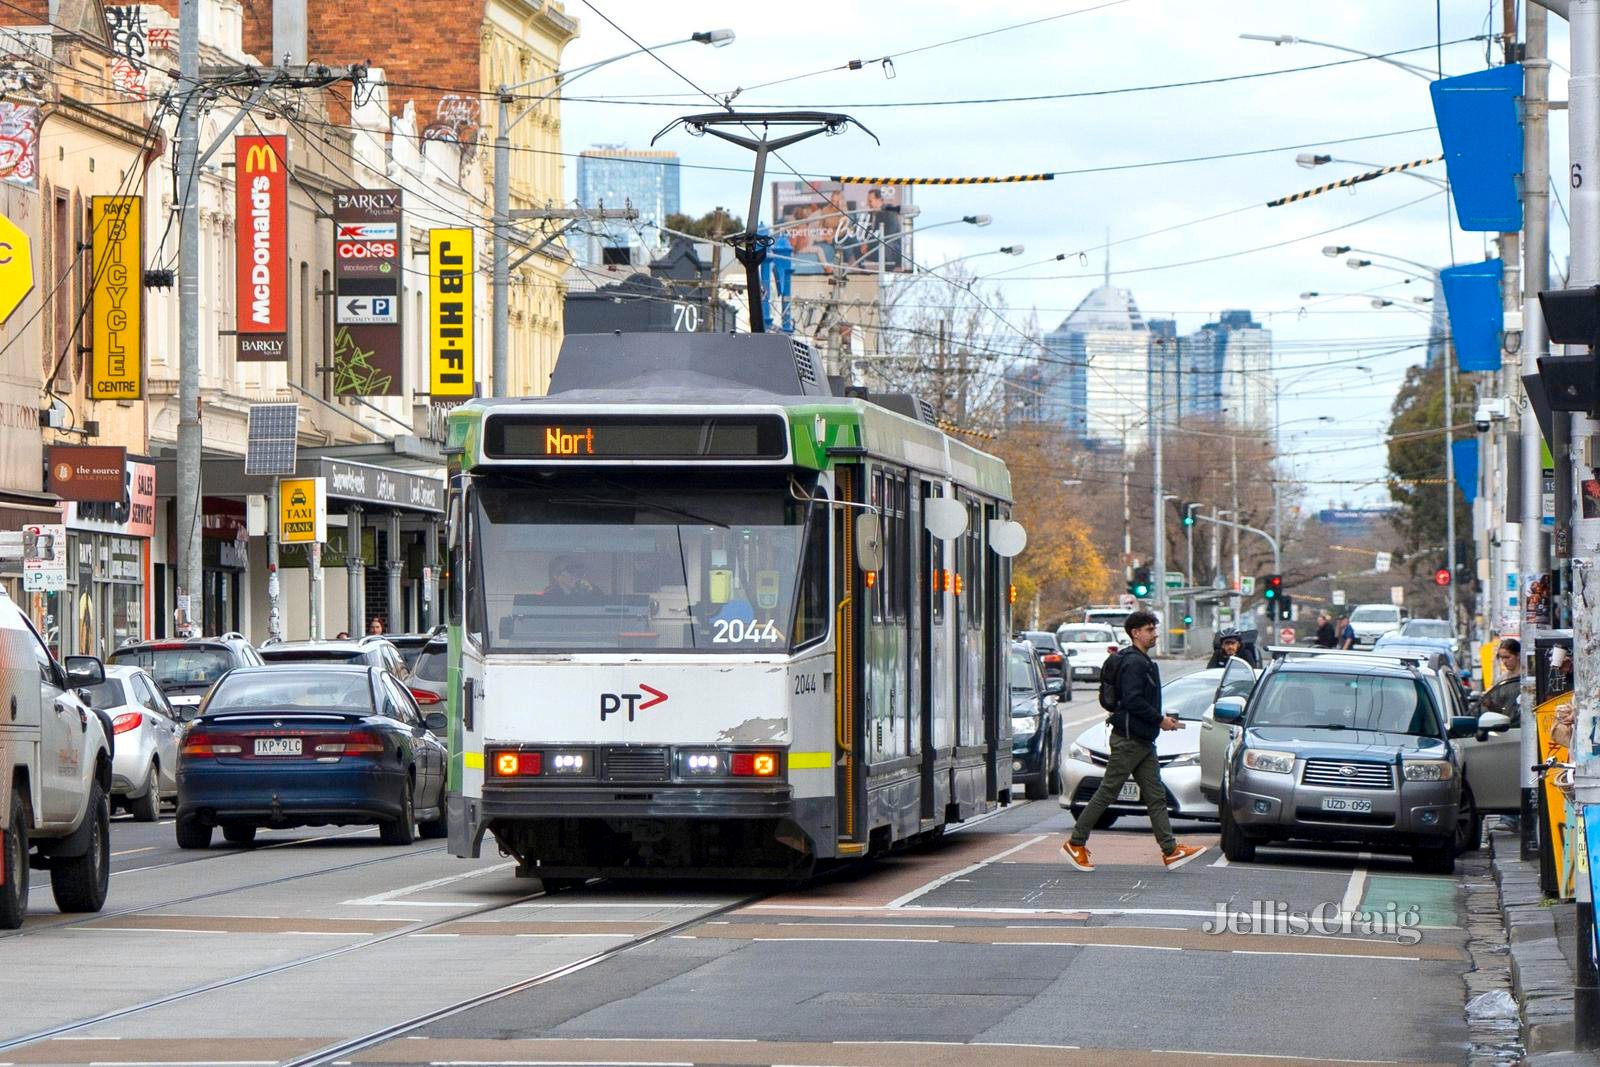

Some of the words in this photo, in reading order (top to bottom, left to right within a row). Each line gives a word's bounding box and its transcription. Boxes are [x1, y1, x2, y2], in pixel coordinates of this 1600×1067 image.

[1571, 163, 1583, 189] 6
[338, 194, 397, 209] BARKLY
[252, 175, 271, 325] McDonald's
[339, 242, 395, 258] coles
[440, 241, 463, 294] JB
[106, 219, 128, 377] BICYCLE
[375, 300, 387, 314] P
[242, 340, 284, 351] BARKLY
[97, 381, 136, 393] CENTRE
[545, 427, 595, 454] Nort
[76, 466, 91, 475] the
[287, 509, 312, 519] TAXI
[285, 523, 313, 533] RANK
[712, 618, 778, 643] 2044
[794, 674, 817, 695] 2044
